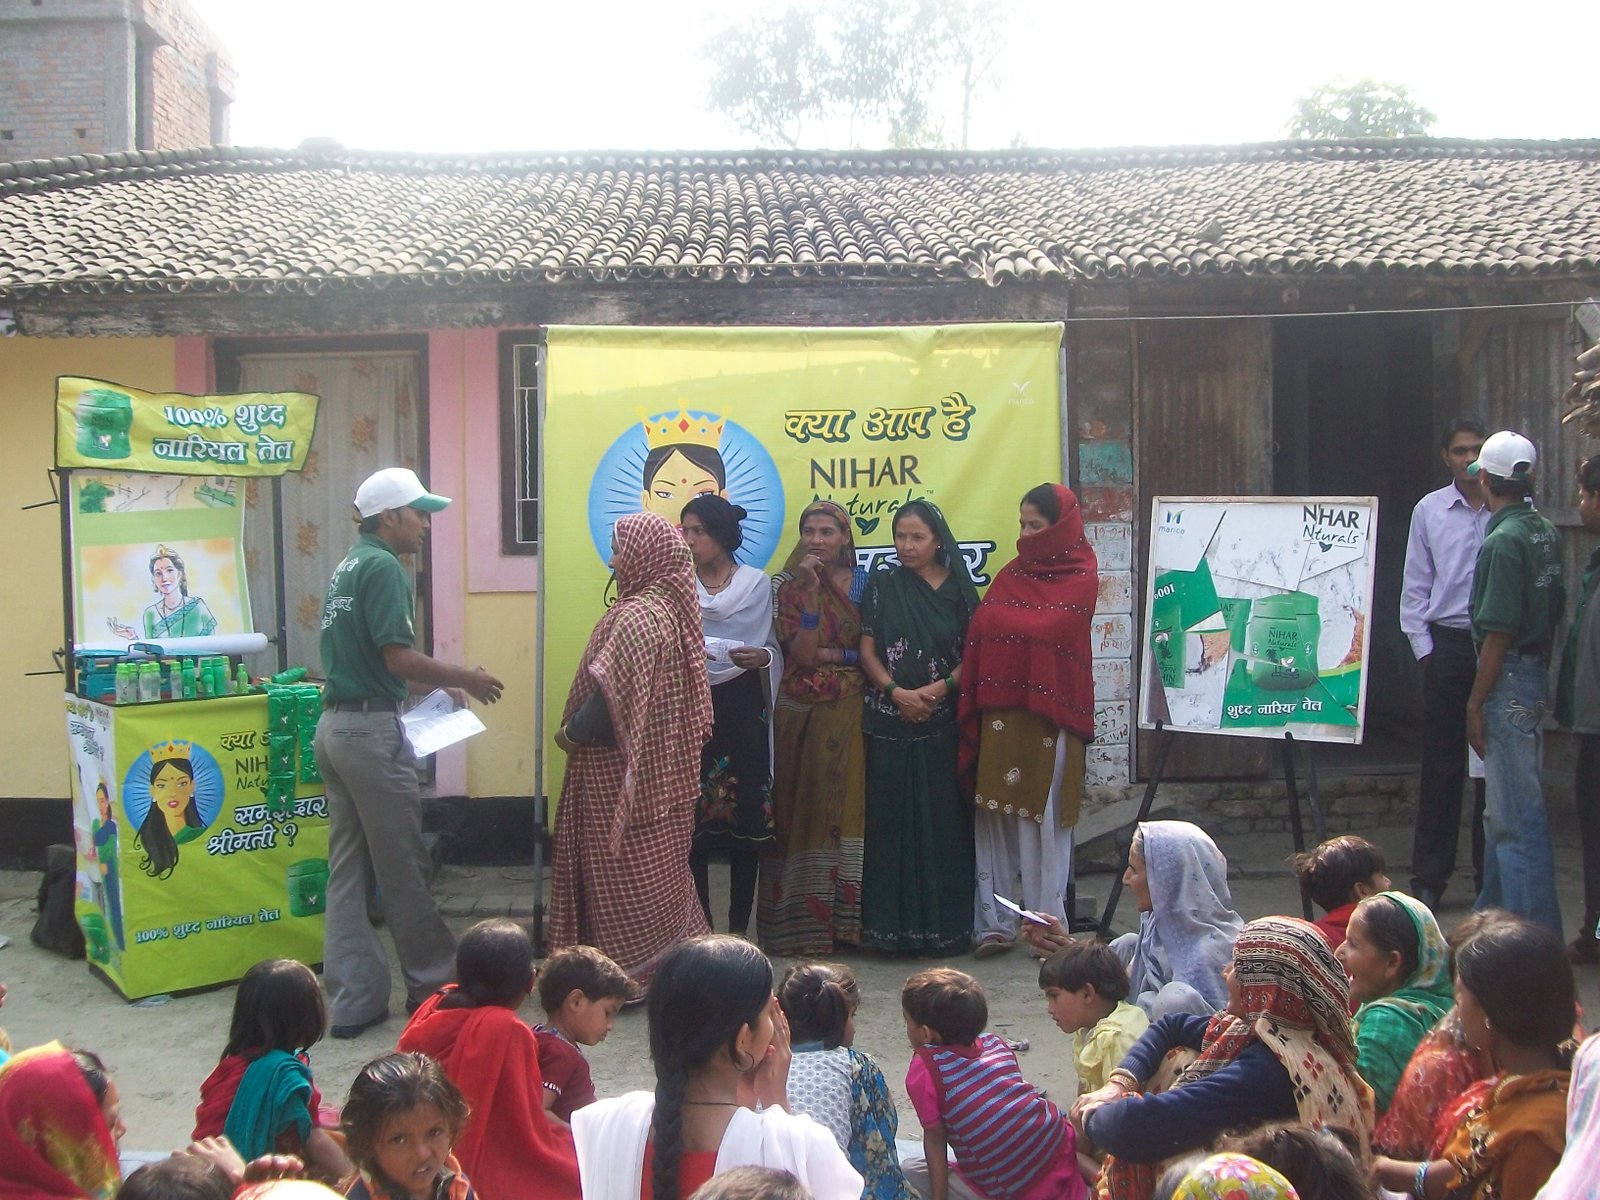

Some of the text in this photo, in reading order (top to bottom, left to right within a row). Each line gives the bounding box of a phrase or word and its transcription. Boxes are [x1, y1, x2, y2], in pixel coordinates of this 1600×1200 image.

[164, 406, 229, 428] 100%
[785, 391, 976, 443] क्या आप है
[153, 433, 295, 464] नारियल तेल
[810, 455, 921, 489] NIHAR
[1158, 525, 1185, 535] marico
[1268, 630, 1298, 640] NIHAR
[1302, 697, 1323, 711] तेल
[220, 731, 256, 751] क्या
[207, 823, 278, 855] श्रीमती
[135, 928, 169, 943] 100%
[206, 914, 254, 930] नारियल
[259, 908, 280, 922] तेल
